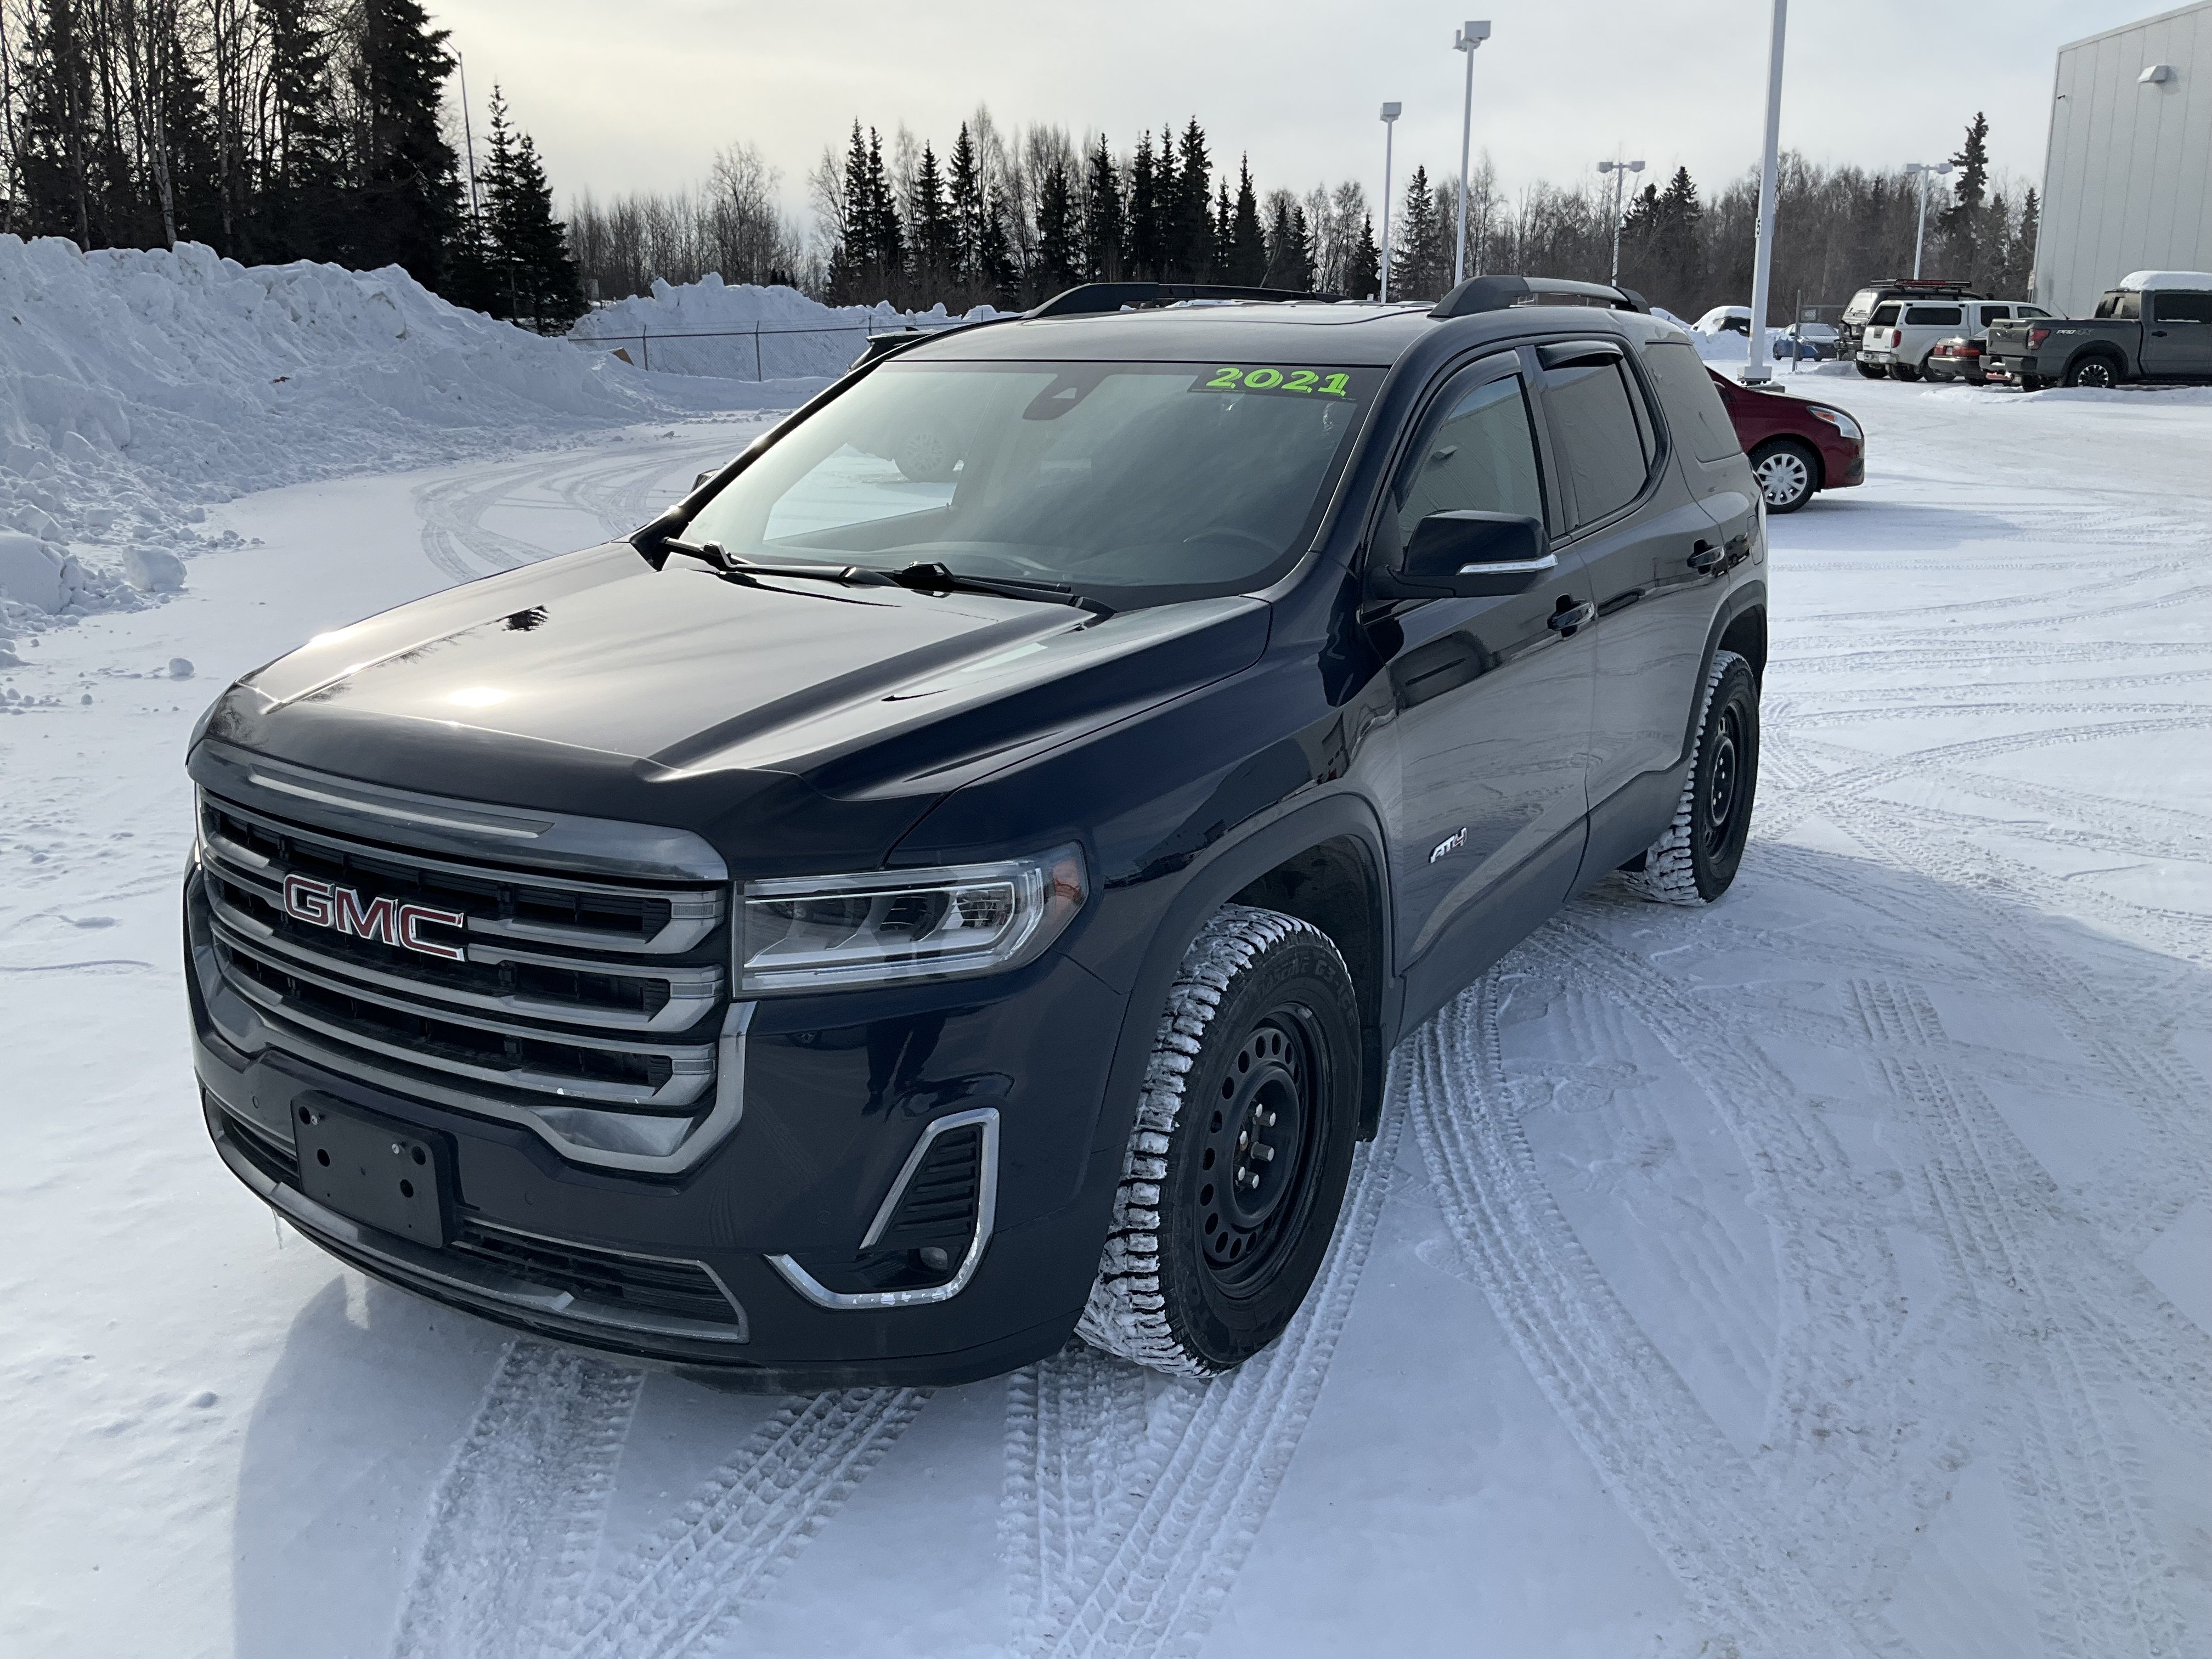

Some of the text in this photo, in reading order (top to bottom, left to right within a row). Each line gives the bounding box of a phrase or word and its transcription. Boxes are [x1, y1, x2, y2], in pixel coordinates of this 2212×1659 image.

[1757, 219, 1760, 235] 5
[1206, 367, 1350, 397] 2021
[1430, 827, 1467, 864] AT4
[283, 873, 465, 962] GMC
